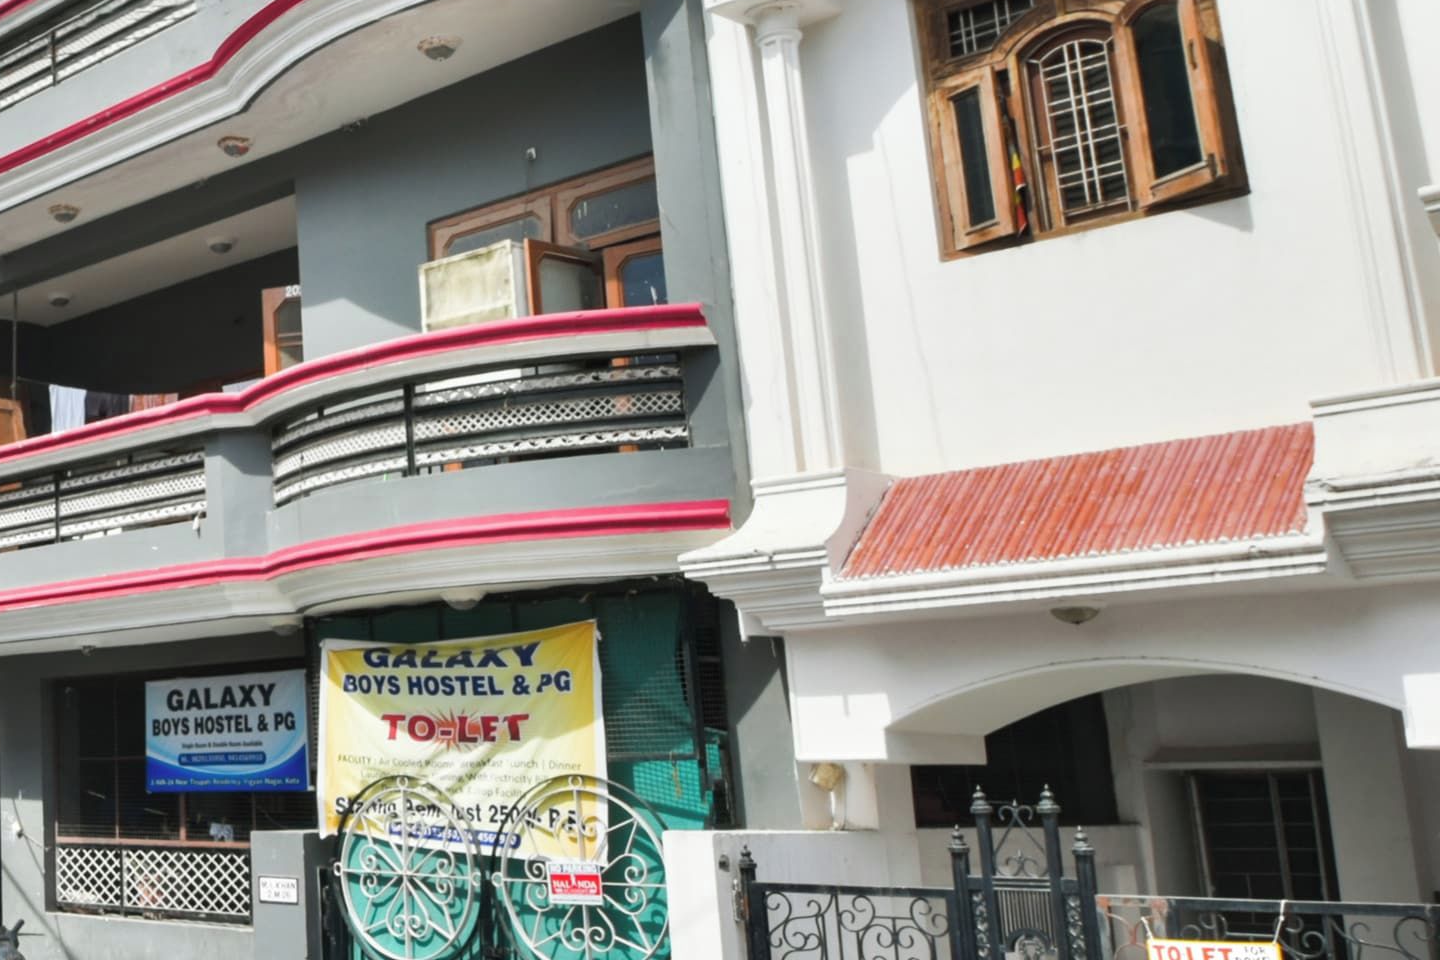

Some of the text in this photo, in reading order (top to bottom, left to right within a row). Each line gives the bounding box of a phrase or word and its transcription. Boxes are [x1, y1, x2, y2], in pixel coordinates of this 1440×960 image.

[363, 642, 540, 668] GALAXY
[343, 671, 571, 695] BOYS HOSTEL & PG
[167, 683, 276, 712] GALAXY
[152, 711, 296, 736] BOYS HOSTEL & PG
[381, 714, 529, 743] TO-LET
[549, 760, 581, 770] Dinner
